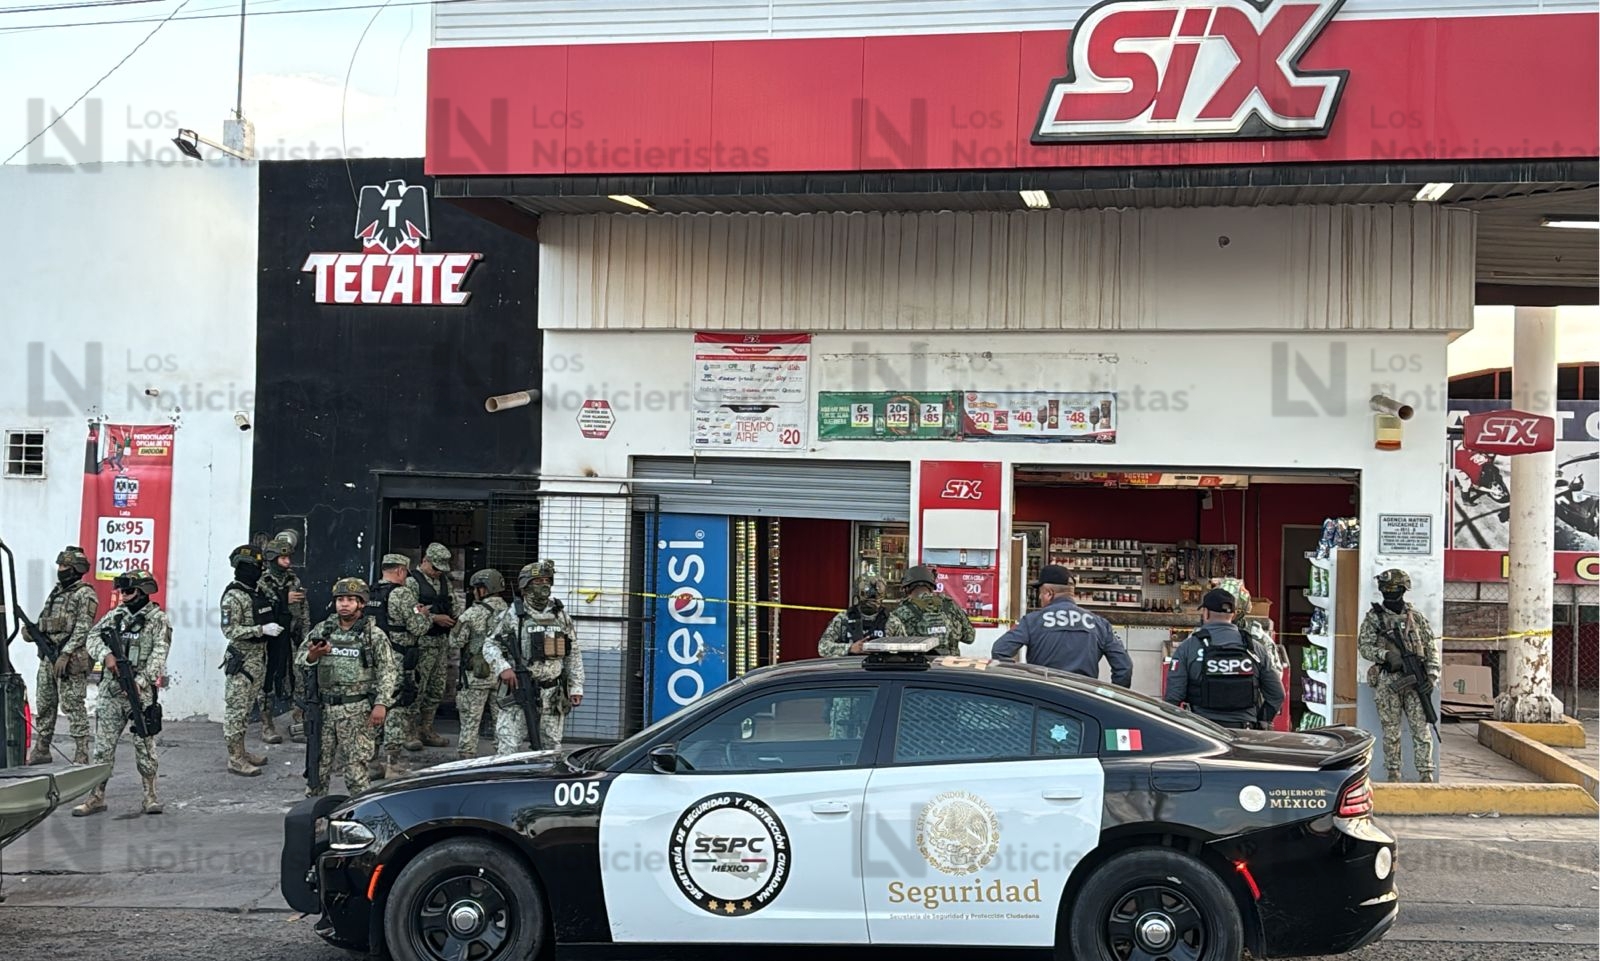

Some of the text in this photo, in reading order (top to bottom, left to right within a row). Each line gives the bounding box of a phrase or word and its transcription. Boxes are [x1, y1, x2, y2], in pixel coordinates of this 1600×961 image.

[302, 254, 477, 304] TECATE
[889, 404, 907, 413] 20x
[888, 414, 908, 423] $125
[735, 421, 775, 433] TIEMPO
[735, 432, 759, 443] AIRE
[779, 429, 801, 445] $20
[1042, 610, 1096, 629] SSPC
[1206, 658, 1252, 673] SSPC
[554, 781, 600, 806] 005
[1269, 789, 1326, 797] GOBIERNO DE
[734, 797, 742, 806] Y
[1270, 796, 1327, 809] MÉXICO
[683, 796, 731, 828] SEGURIDAD
[936, 791, 965, 801] UNIDOS
[967, 792, 999, 830] MEXICANOS
[743, 800, 787, 850] PROTECCIÓN
[675, 829, 687, 844] DE
[693, 837, 766, 853] SSPC
[670, 851, 704, 900] SECRETARÍA
[711, 862, 750, 873] MÉXICO
[756, 852, 787, 903] CIUDADANA
[888, 878, 1042, 910] Seguridad
